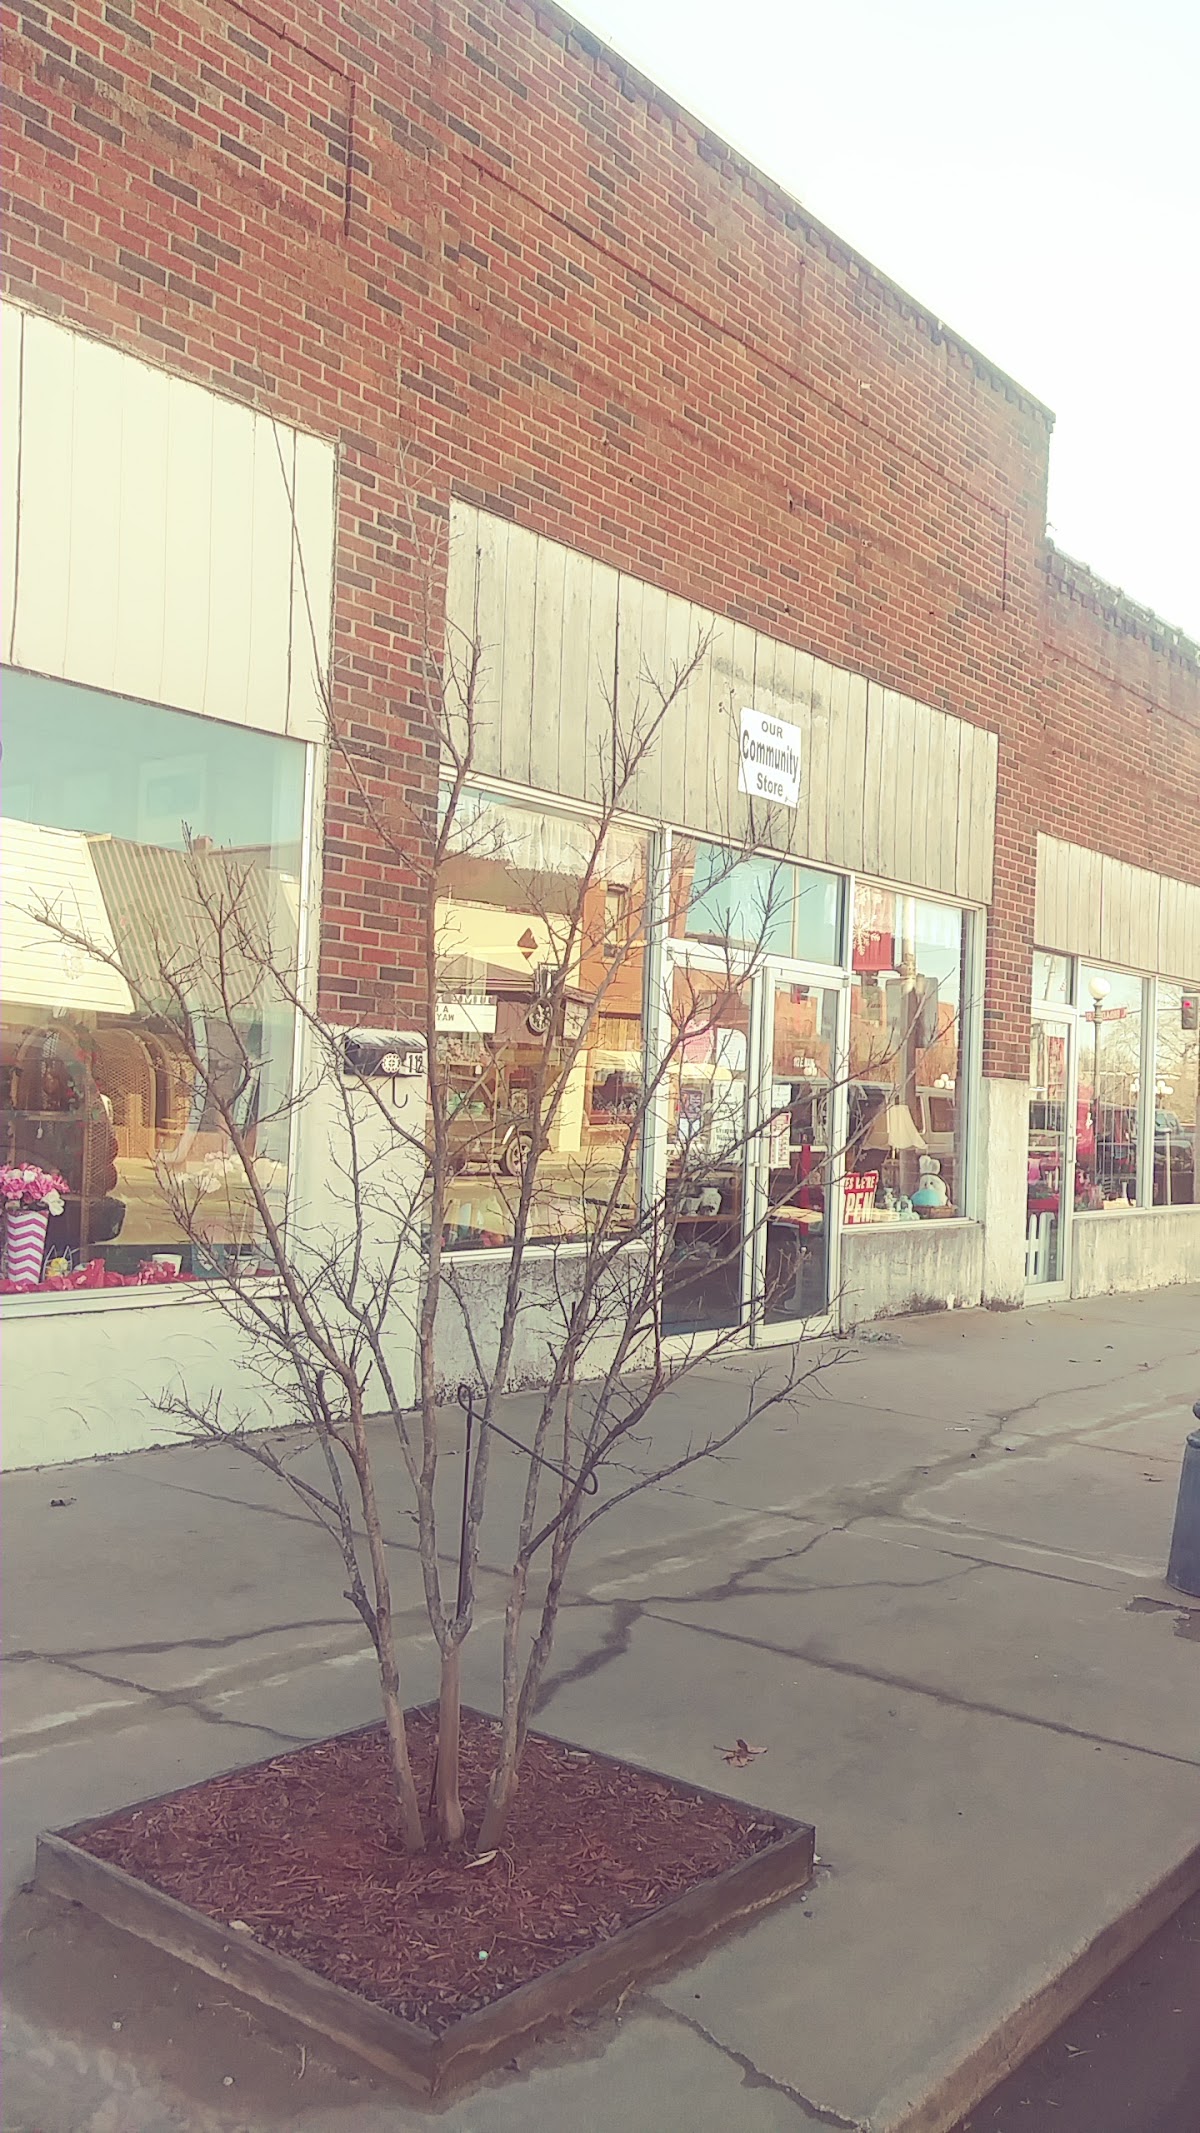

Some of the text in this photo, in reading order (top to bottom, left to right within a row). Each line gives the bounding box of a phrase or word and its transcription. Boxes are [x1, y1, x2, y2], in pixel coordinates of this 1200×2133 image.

[761, 720, 783, 739] OUR
[742, 729, 799, 784] Community
[756, 772, 784, 797] Store
[408, 1054, 423, 1074] 112
[844, 1191, 874, 1224] PEN
